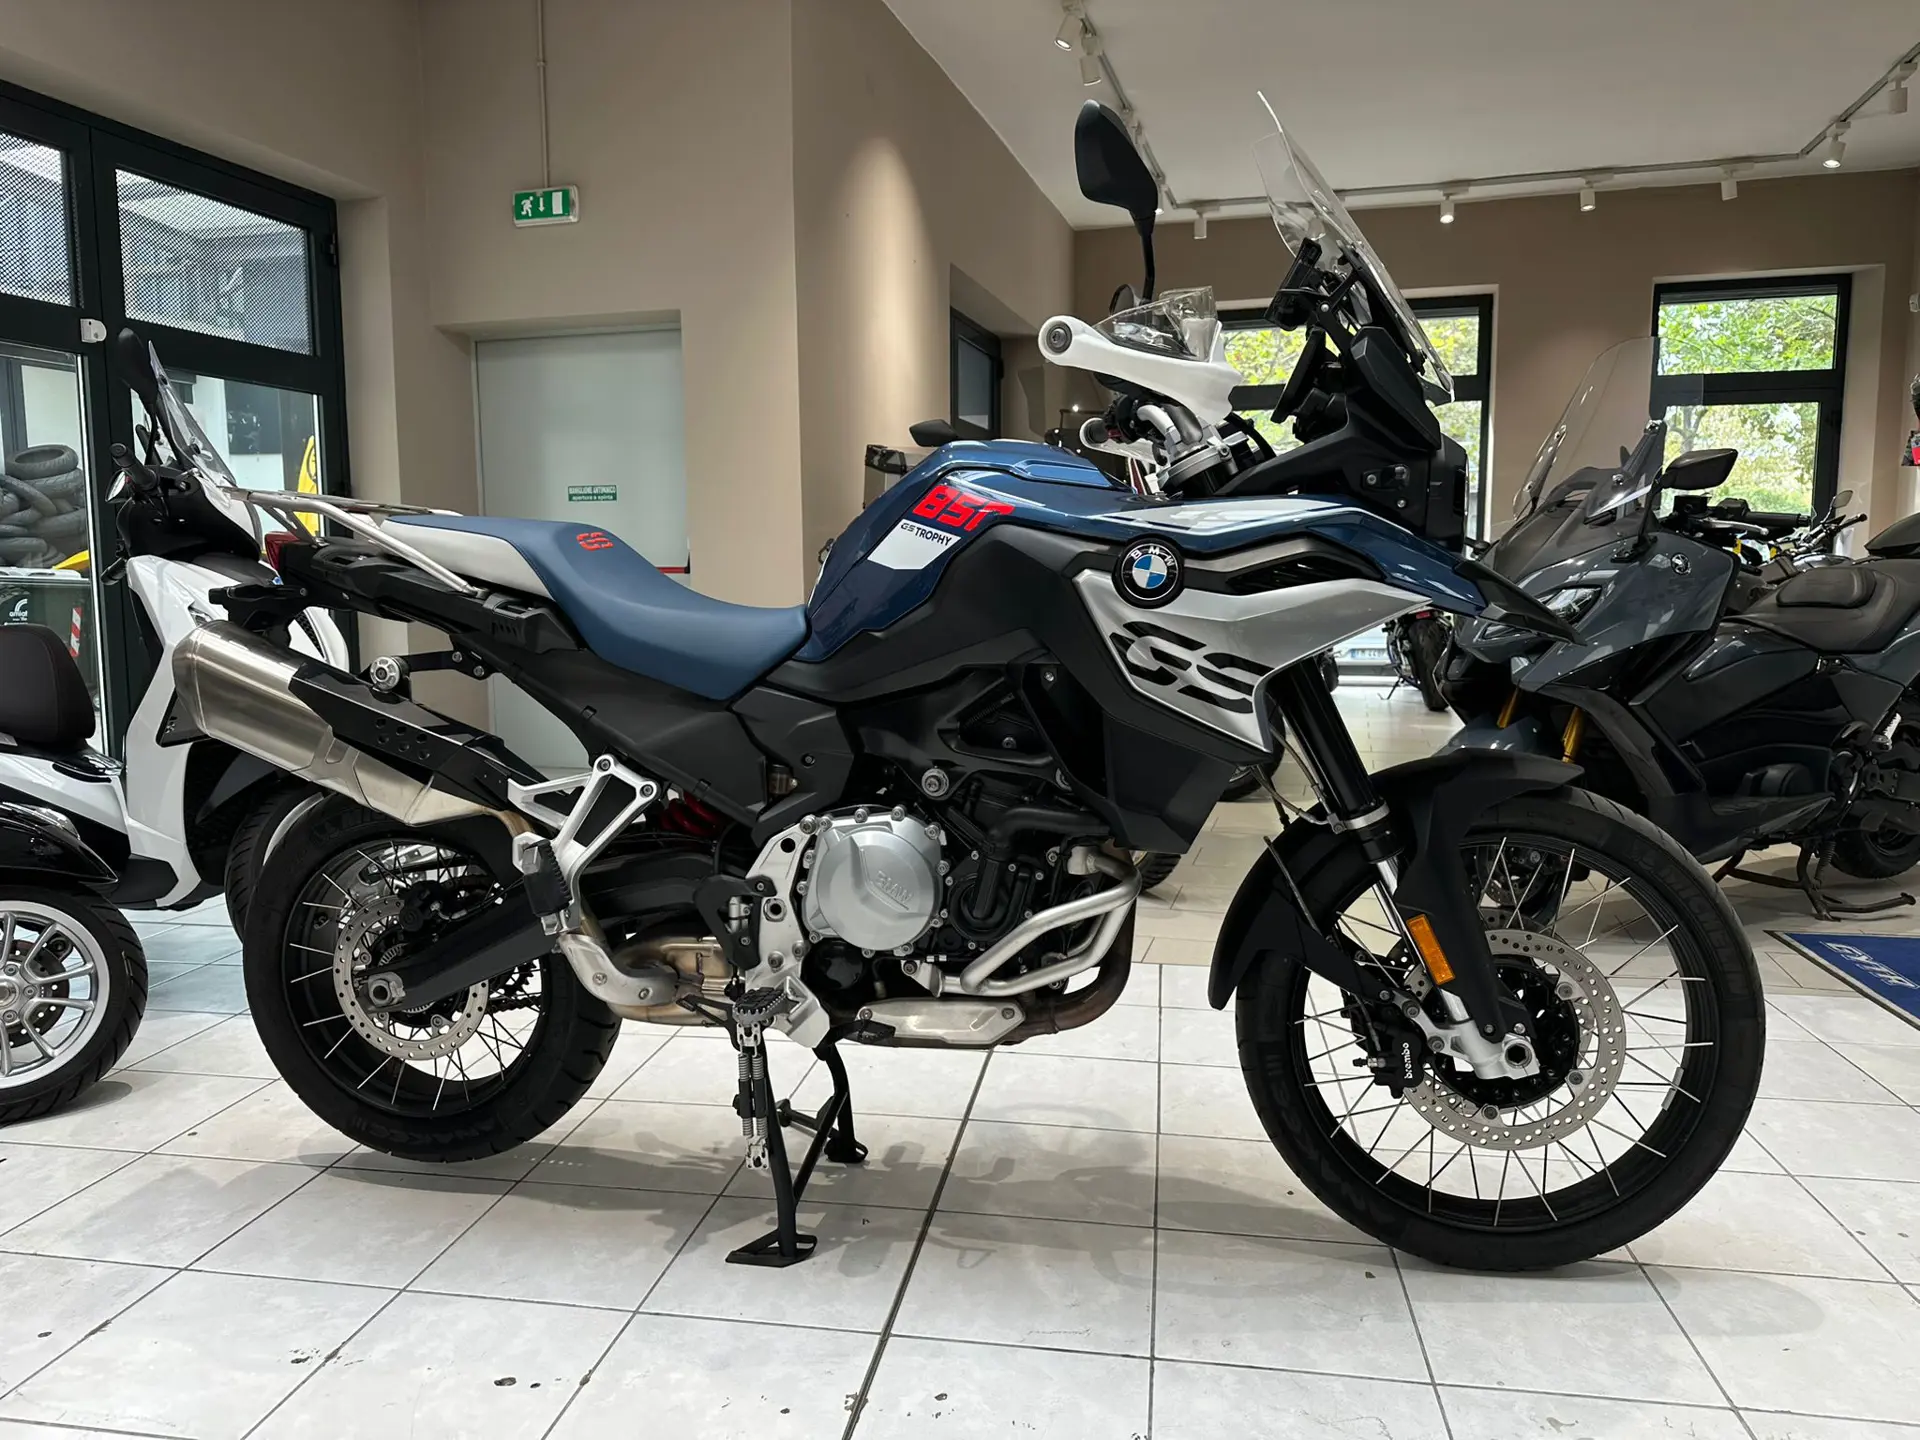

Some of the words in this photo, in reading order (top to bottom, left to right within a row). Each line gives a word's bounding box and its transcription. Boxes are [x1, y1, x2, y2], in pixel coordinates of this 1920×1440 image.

[576, 532, 614, 551] GS
[901, 522, 916, 533] GS
[914, 526, 953, 547] TROPHY
[1131, 545, 1176, 567] BMW
[1110, 621, 1276, 714] GS
[877, 869, 915, 903] BMW
[1401, 1042, 1413, 1079] brembo
